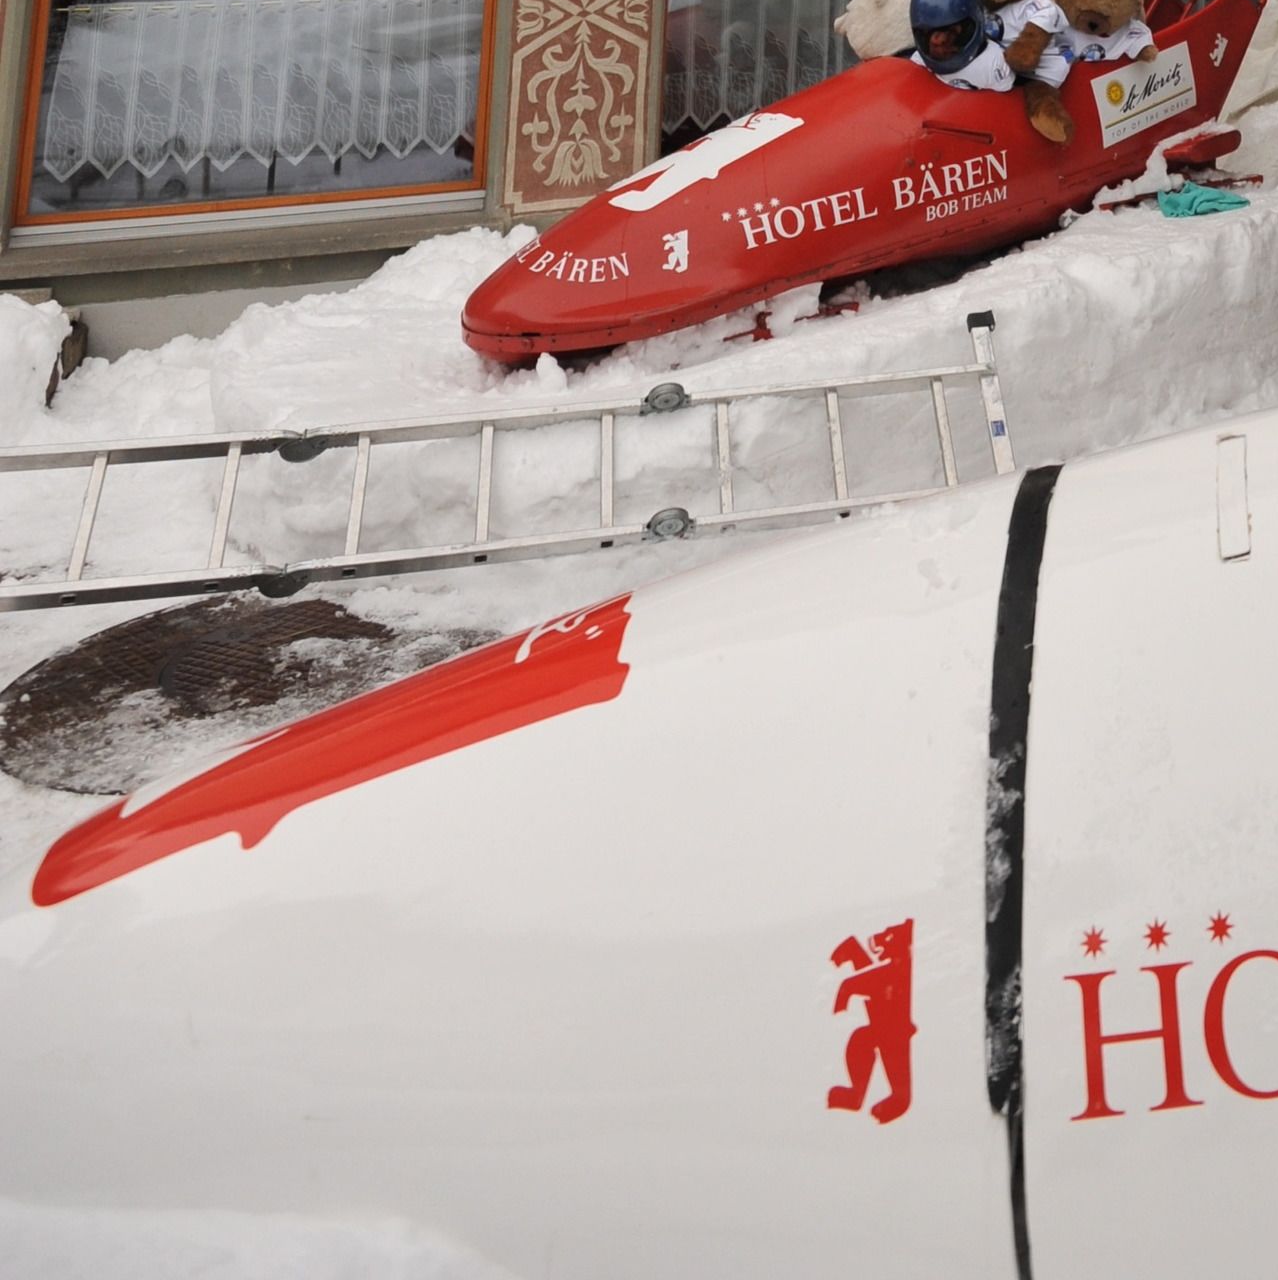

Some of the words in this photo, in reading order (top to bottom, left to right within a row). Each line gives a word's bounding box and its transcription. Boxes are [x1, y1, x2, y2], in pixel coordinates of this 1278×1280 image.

[1137, 62, 1183, 104] Moritz
[1111, 127, 1127, 139] TOP
[1131, 120, 1141, 130] OF
[1145, 112, 1159, 124] THE
[1163, 97, 1189, 115] WORLD
[739, 187, 879, 250] HOTEL
[891, 150, 1009, 210] BÄREN
[926, 201, 959, 222] BOB
[962, 186, 1007, 213] TEAM
[529, 251, 630, 283] BÄREN
